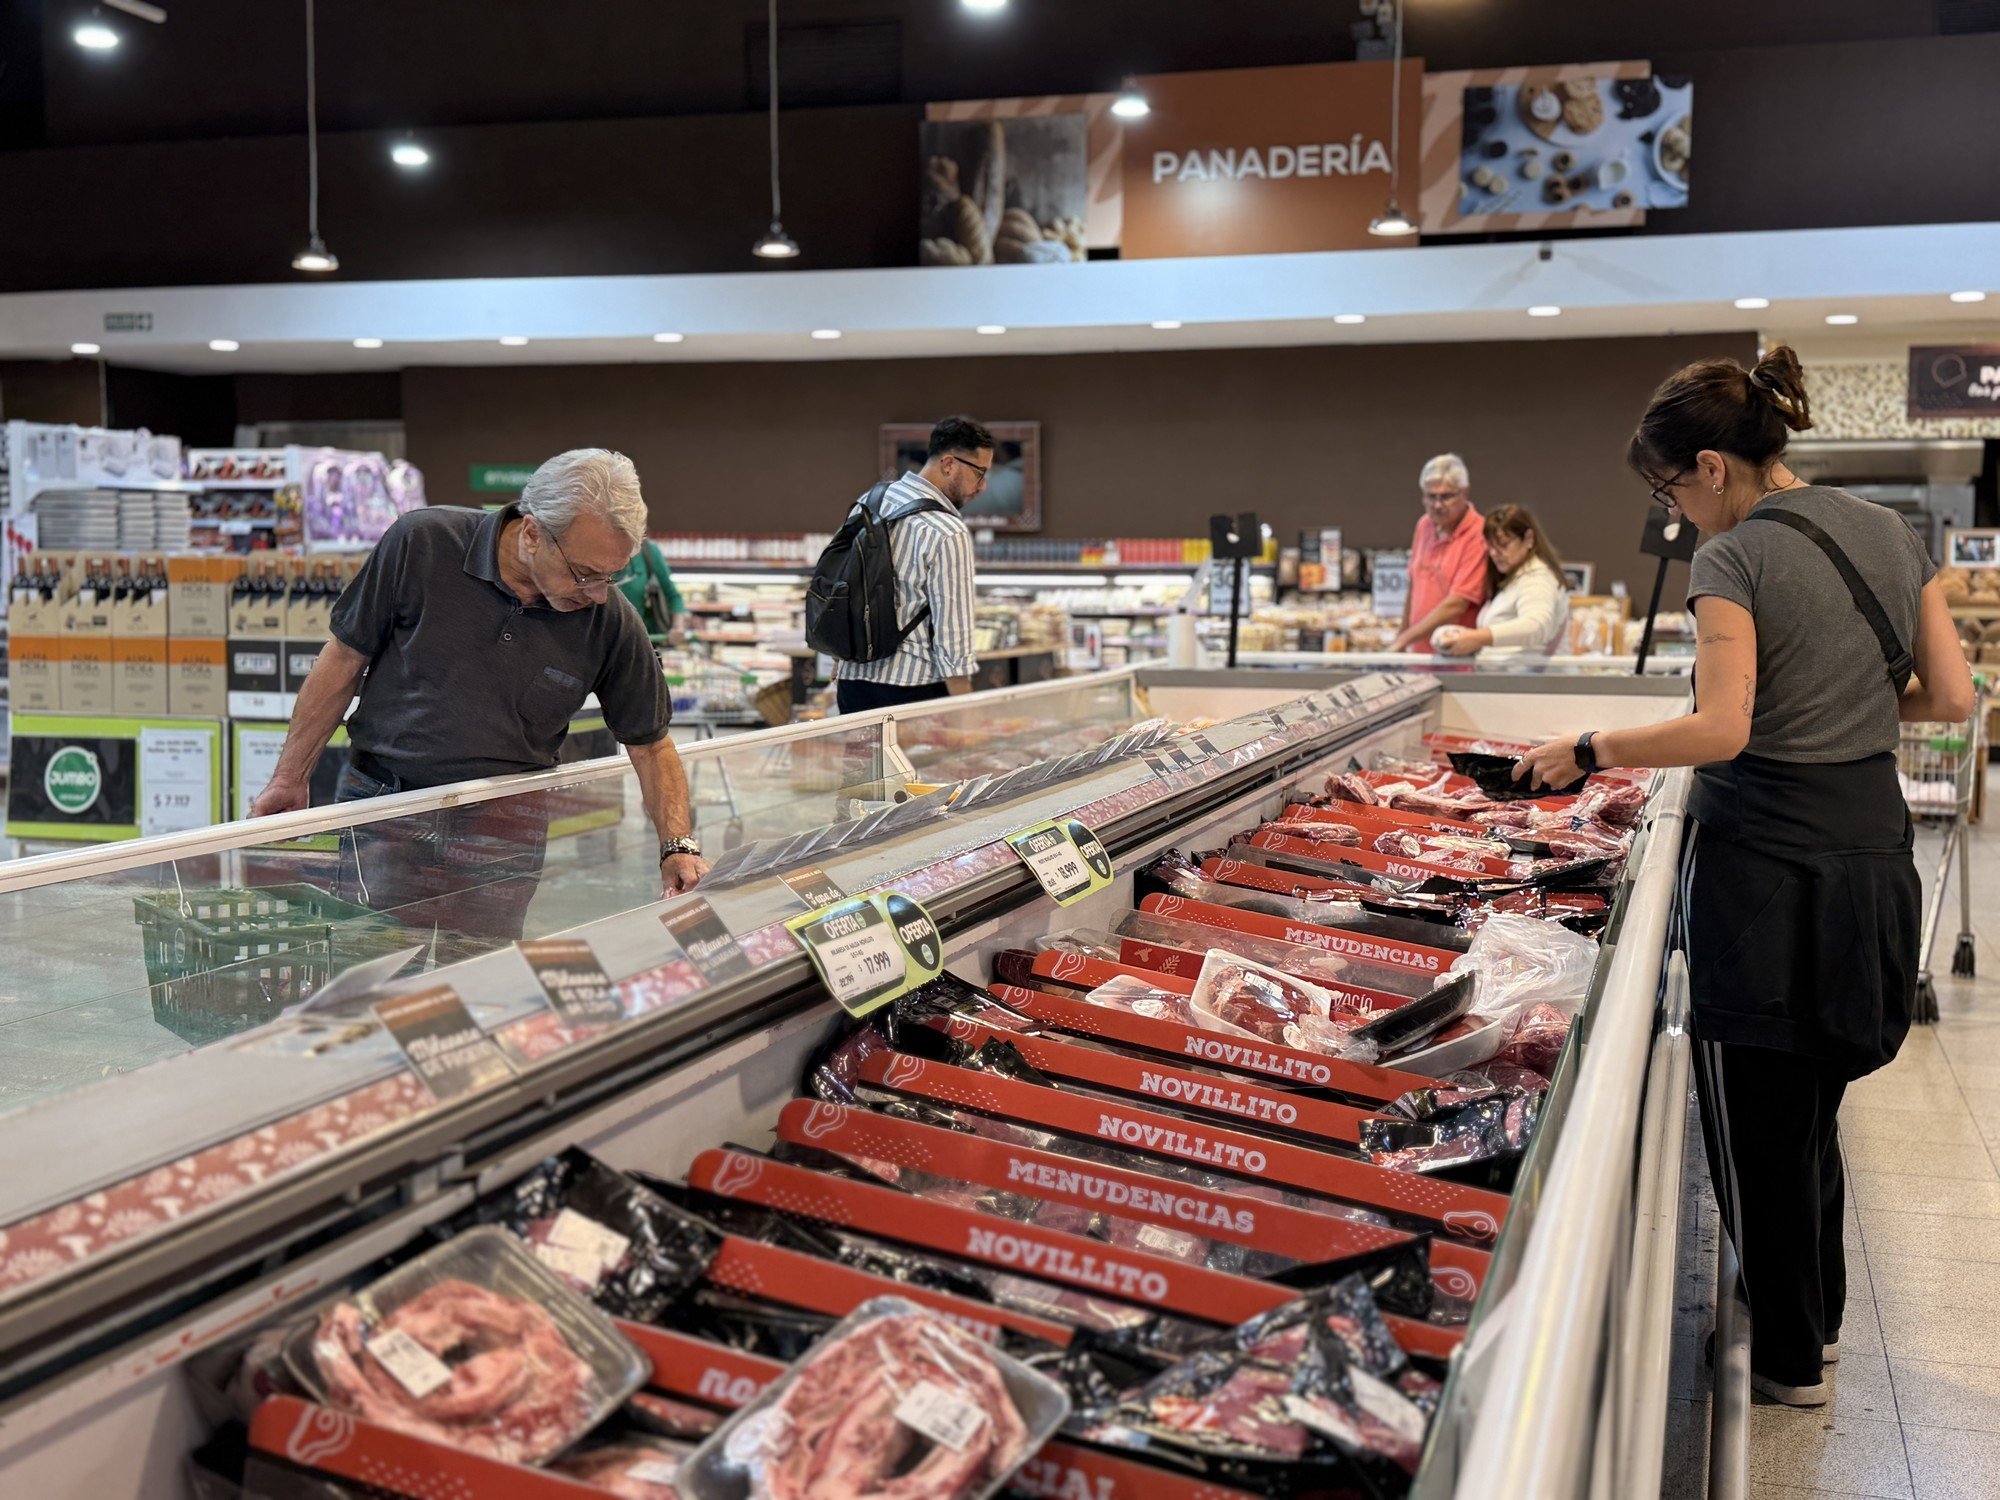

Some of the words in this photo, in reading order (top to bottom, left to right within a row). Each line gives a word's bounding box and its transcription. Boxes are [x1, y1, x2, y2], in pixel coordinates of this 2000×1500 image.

[1152, 132, 1392, 184] PANADERÍA
[49, 770, 97, 787] JUMBO
[1028, 833, 1054, 853] OFERTA
[1079, 840, 1104, 859] OFERTA
[823, 914, 861, 939] OFERTA
[899, 917, 934, 945] OFERTA
[687, 934, 733, 960] Milanesa
[863, 951, 891, 975] 17.999
[1284, 927, 1439, 970] MENUDENCIAS
[1184, 1035, 1331, 1084] NOVILLITO
[1139, 1071, 1297, 1124] NOVILLITO
[1098, 1114, 1266, 1173] NOVILLITO
[1007, 1158, 1255, 1234] MENUDENCIAS
[966, 1226, 1168, 1300] NOVILLITO
